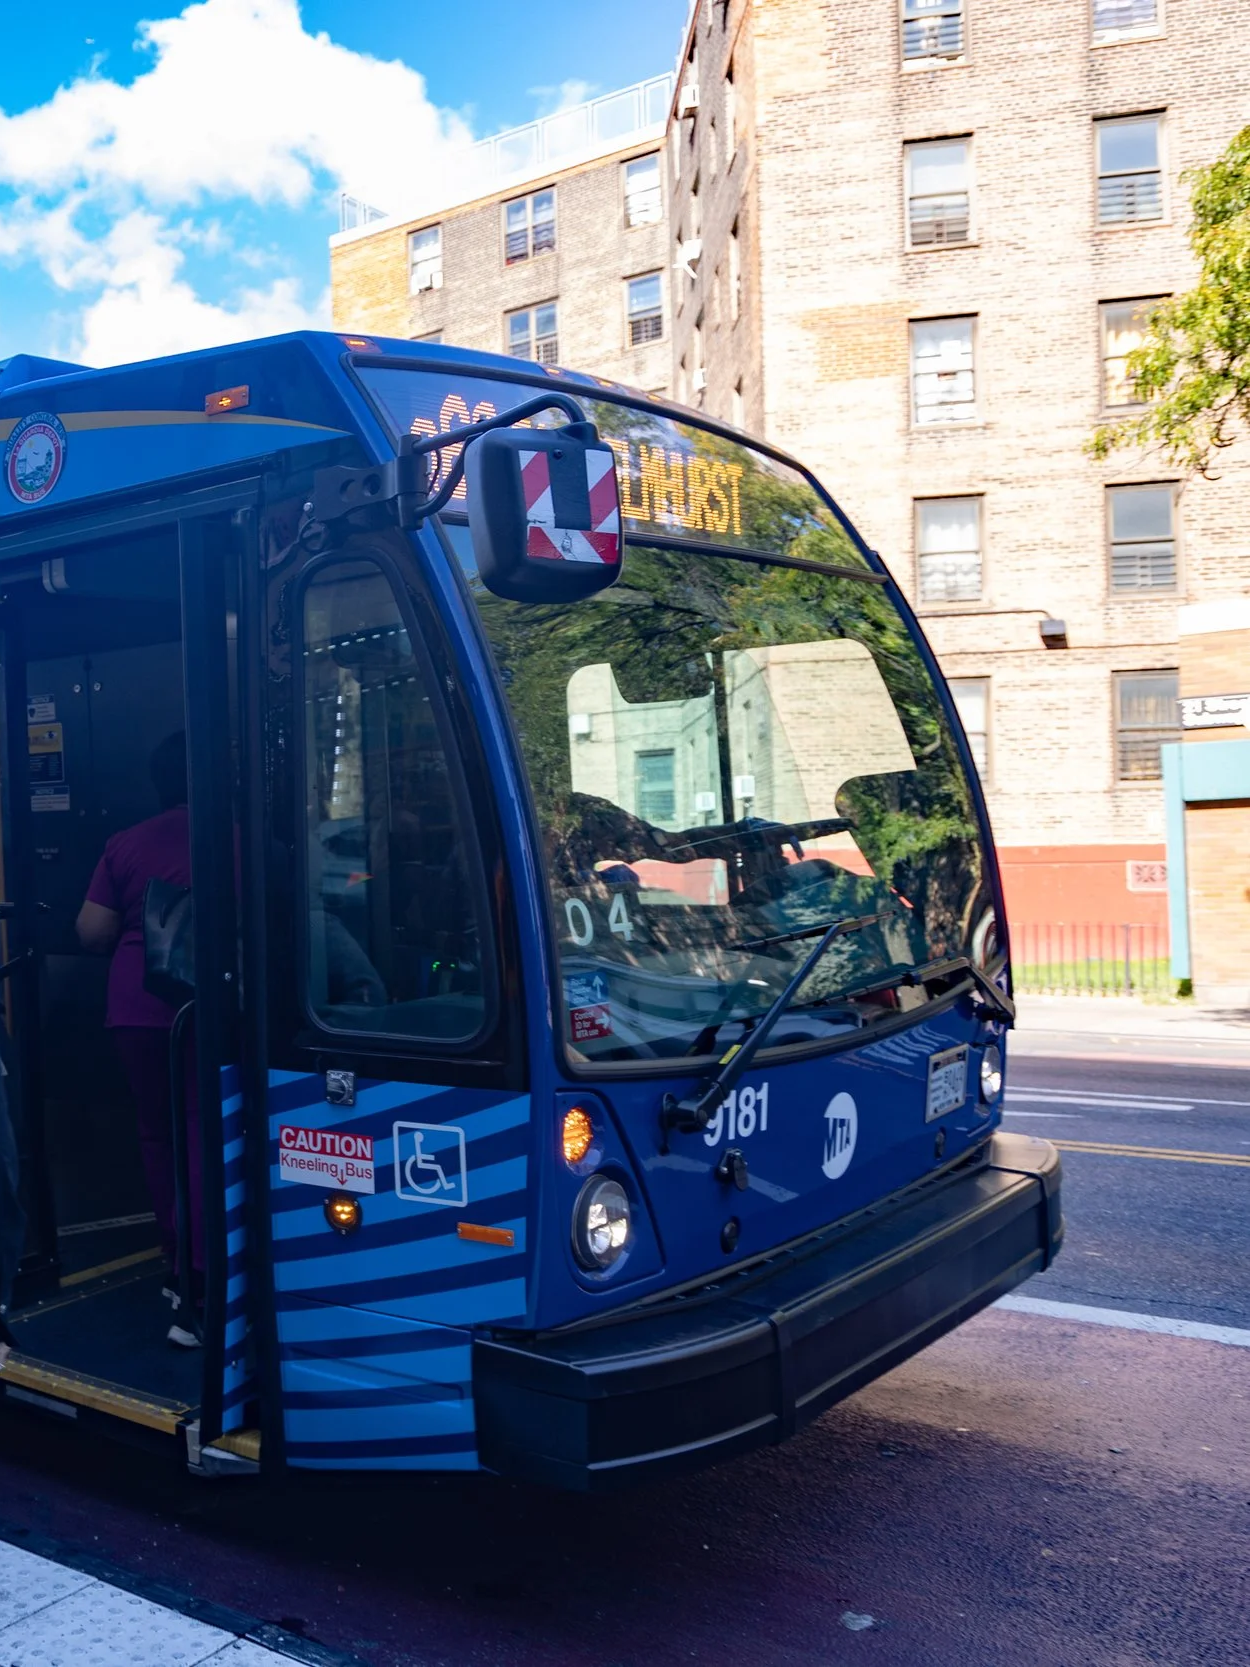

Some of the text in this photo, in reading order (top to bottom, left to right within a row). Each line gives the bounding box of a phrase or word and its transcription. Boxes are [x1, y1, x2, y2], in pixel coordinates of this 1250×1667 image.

[44, 427, 59, 448] DEPOT
[281, 1127, 372, 1159] CAUTION
[281, 1152, 373, 1180] Kneeling Bus
